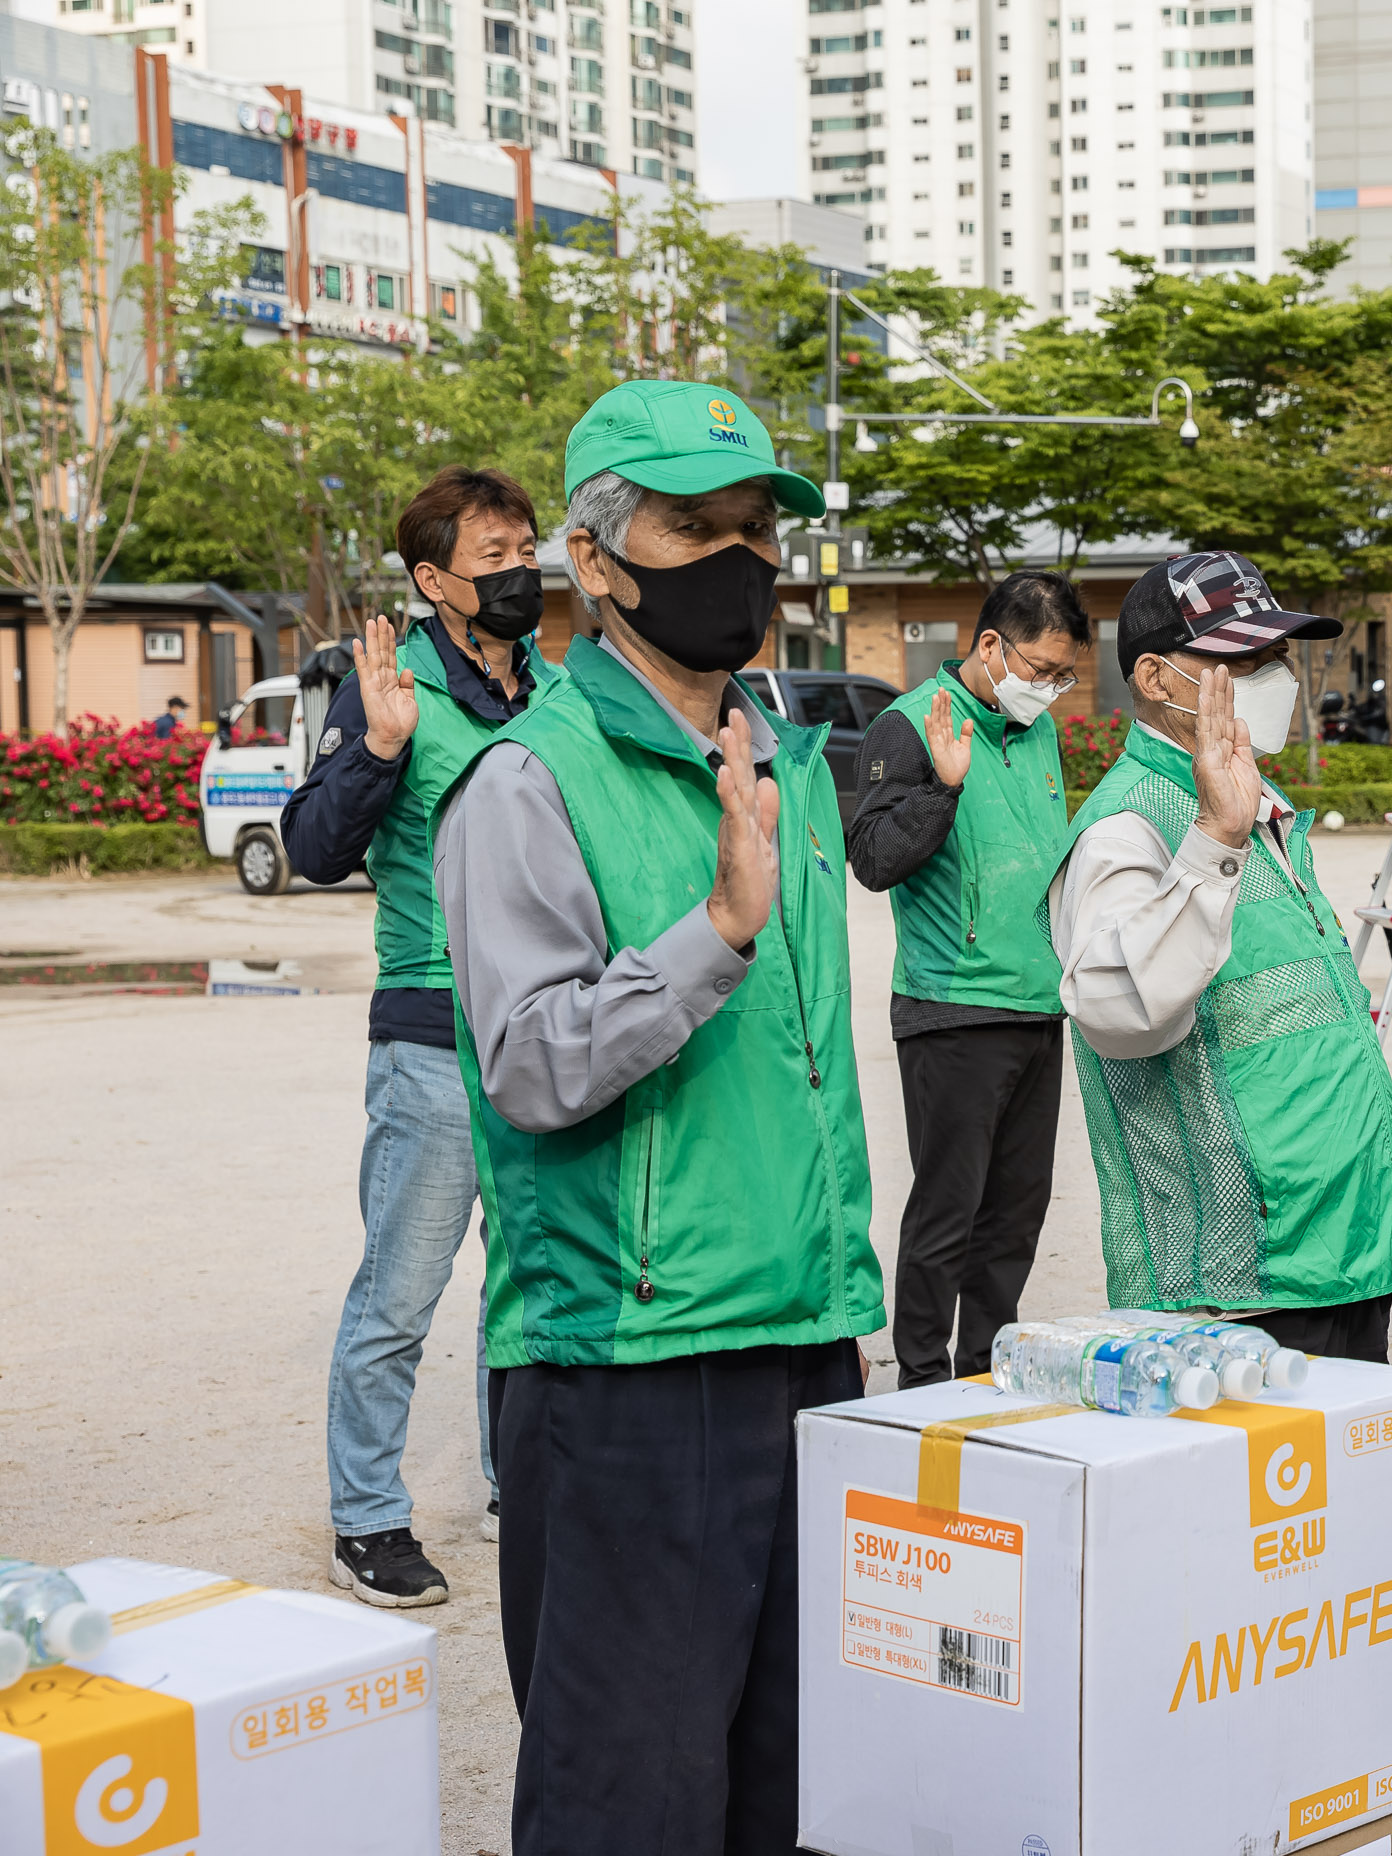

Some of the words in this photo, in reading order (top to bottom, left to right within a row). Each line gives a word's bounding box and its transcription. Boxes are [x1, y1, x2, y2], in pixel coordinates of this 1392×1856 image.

[709, 427, 750, 449] SMU
[944, 1520, 1015, 1547] ANYSAFE
[1254, 1517, 1325, 1572] E&W
[854, 1532, 899, 1562] SBW
[902, 1543, 951, 1574] J100
[853, 1560, 892, 1583] 투피스
[896, 1570, 922, 1592] 회색
[1264, 1560, 1319, 1583] EVERWELL
[857, 1614, 881, 1632] 일반형
[885, 1621, 912, 1640] 대형(L)
[857, 1643, 881, 1661] 일반형
[885, 1650, 927, 1673] 특대형(XL)
[243, 1695, 330, 1749] 일회용
[345, 1665, 427, 1715] 작업복
[1300, 1801, 1324, 1826] ISO
[1326, 1789, 1360, 1816] 9001
